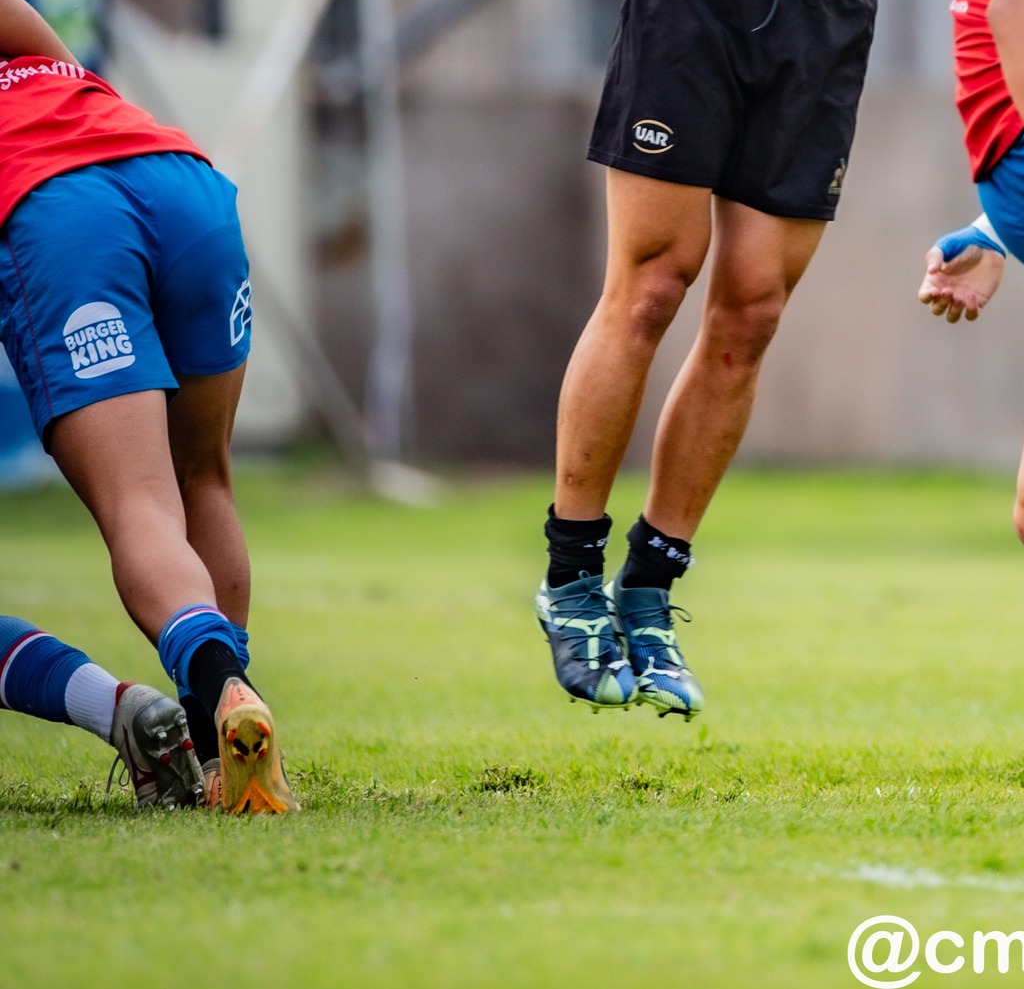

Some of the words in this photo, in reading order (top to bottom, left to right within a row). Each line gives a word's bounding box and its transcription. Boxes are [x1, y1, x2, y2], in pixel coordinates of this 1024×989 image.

[635, 125, 669, 147] UAR
[64, 319, 127, 351] BURGER
[70, 334, 133, 371] KING
